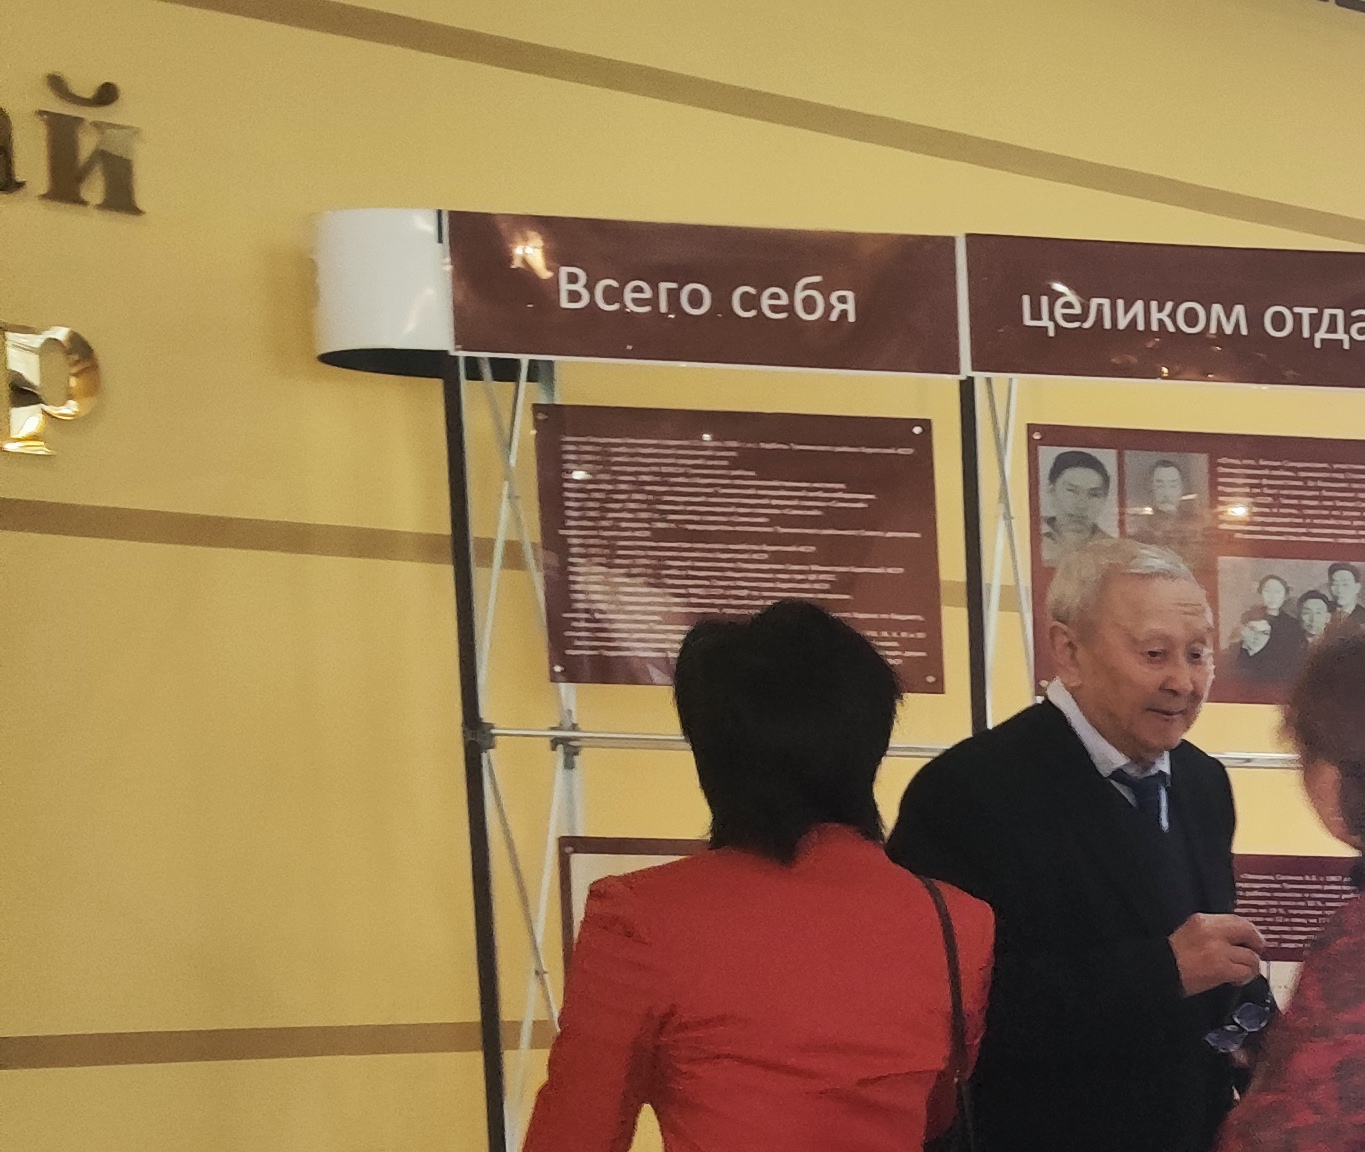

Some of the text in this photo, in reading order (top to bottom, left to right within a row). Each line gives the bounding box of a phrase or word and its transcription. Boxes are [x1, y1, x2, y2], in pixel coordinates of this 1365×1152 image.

[558, 265, 857, 323] Всего себя
[1021, 293, 1249, 337] целиком
